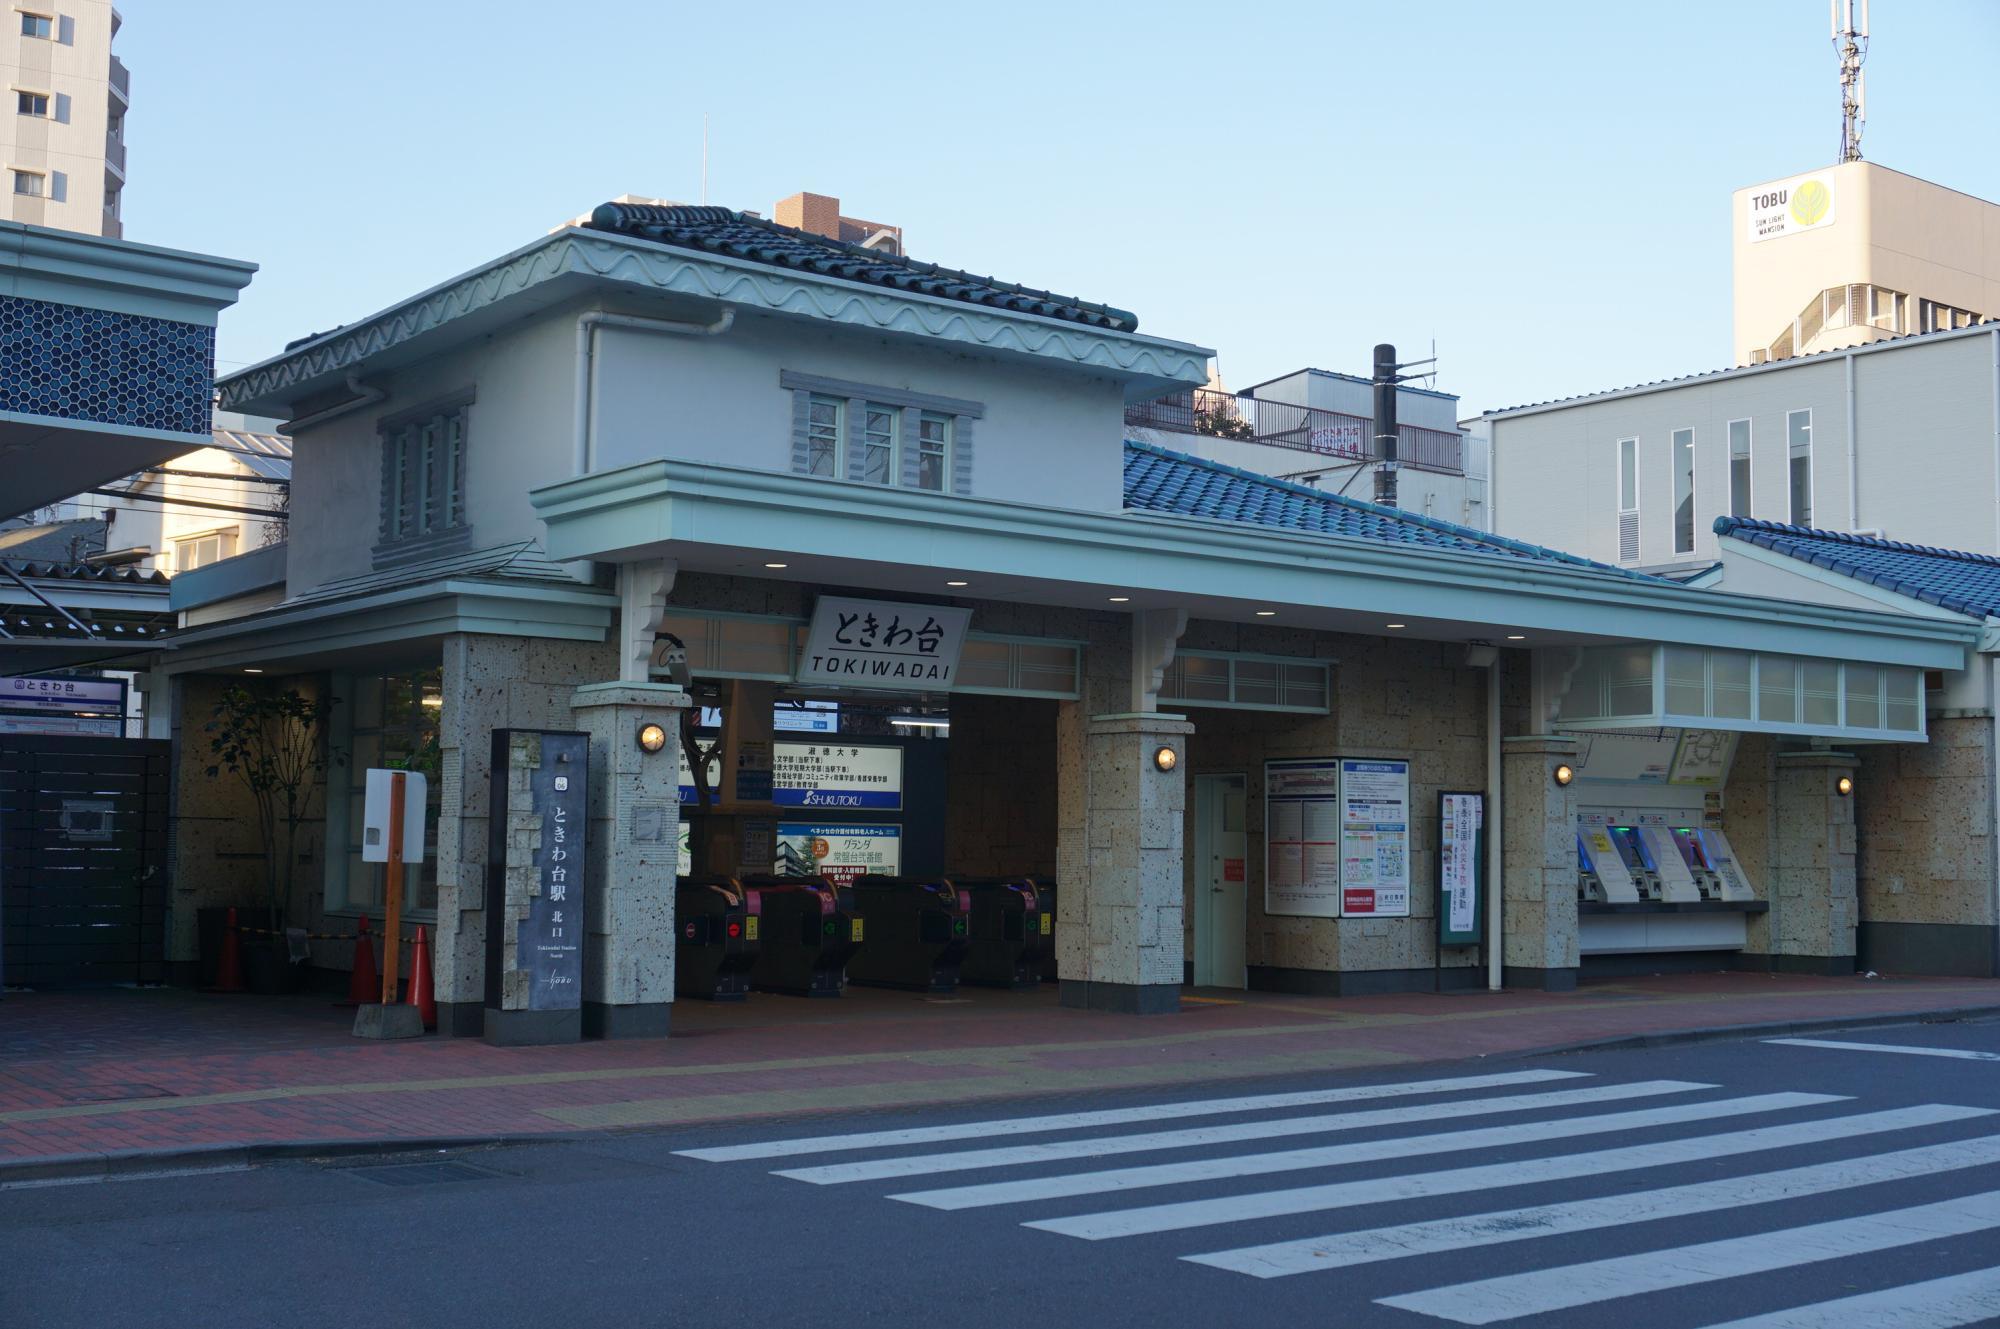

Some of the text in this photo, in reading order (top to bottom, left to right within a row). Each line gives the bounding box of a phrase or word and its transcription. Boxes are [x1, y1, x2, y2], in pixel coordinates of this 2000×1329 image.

[1752, 189, 1787, 211] TOBU
[1755, 214, 1784, 228] SUN LIGHT
[1759, 223, 1785, 235] MANSION
[836, 612, 944, 653] ときわ台
[812, 656, 949, 680] TOKIWADAI
[27, 680, 75, 692] ときわ台
[843, 838, 872, 850] グランダ
[550, 807, 567, 937] ときわ台駅 北口
